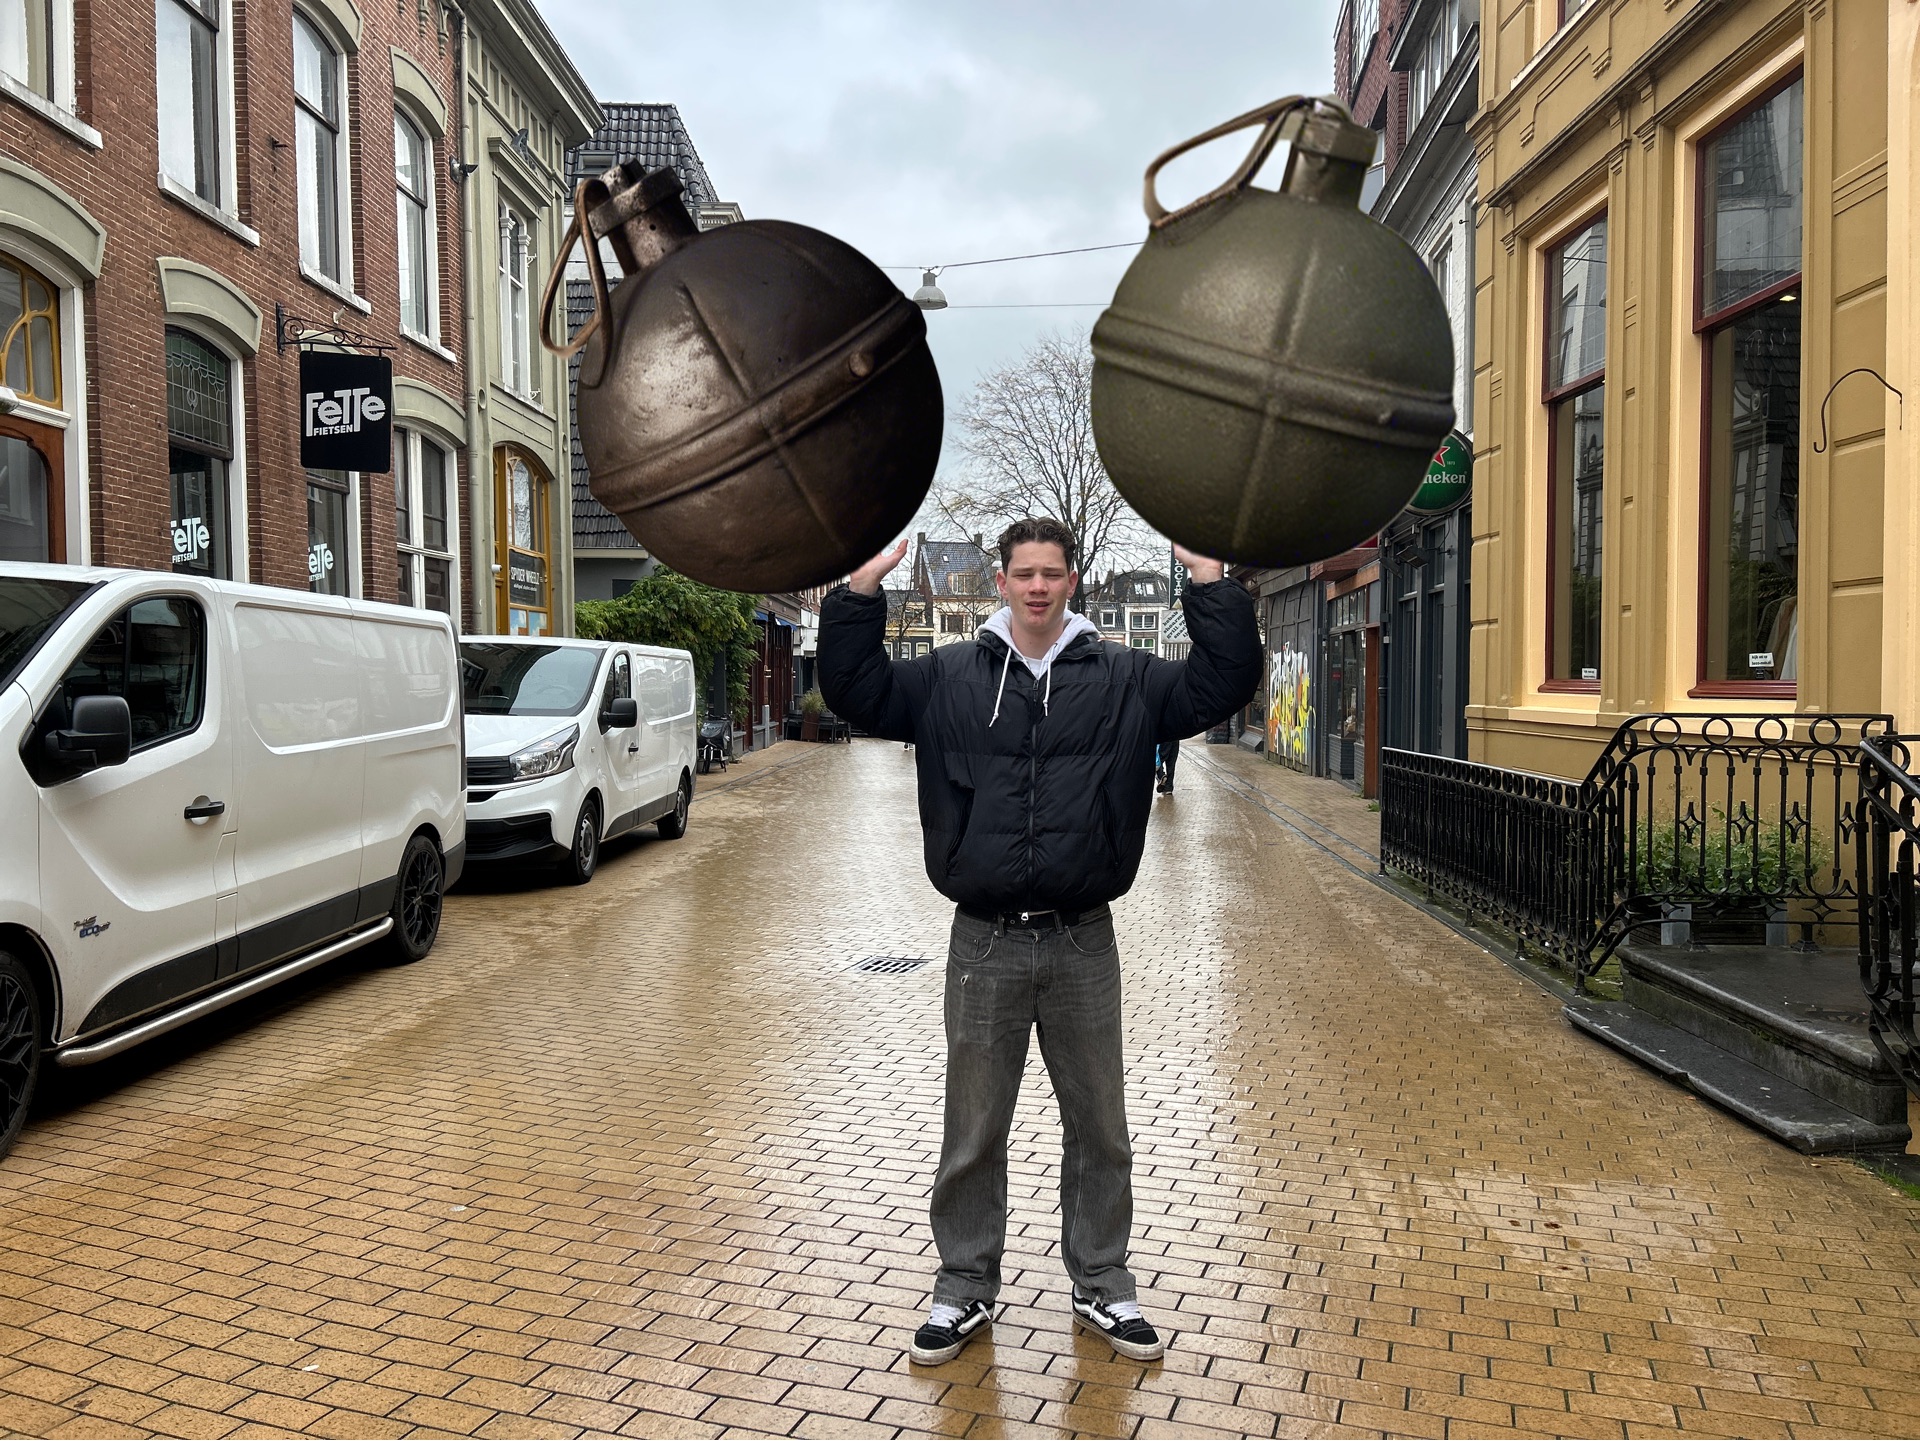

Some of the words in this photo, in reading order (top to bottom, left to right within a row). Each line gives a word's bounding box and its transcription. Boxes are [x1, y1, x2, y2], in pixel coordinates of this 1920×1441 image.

[313, 424, 354, 436] FIETSEN
[1423, 471, 1466, 484] neken
[172, 552, 194, 563] FIETSEN
[308, 543, 334, 579] eTTe
[1163, 611, 1179, 626] kebab
[1164, 612, 1184, 633] shoarm
[1174, 625, 1187, 639] snac
